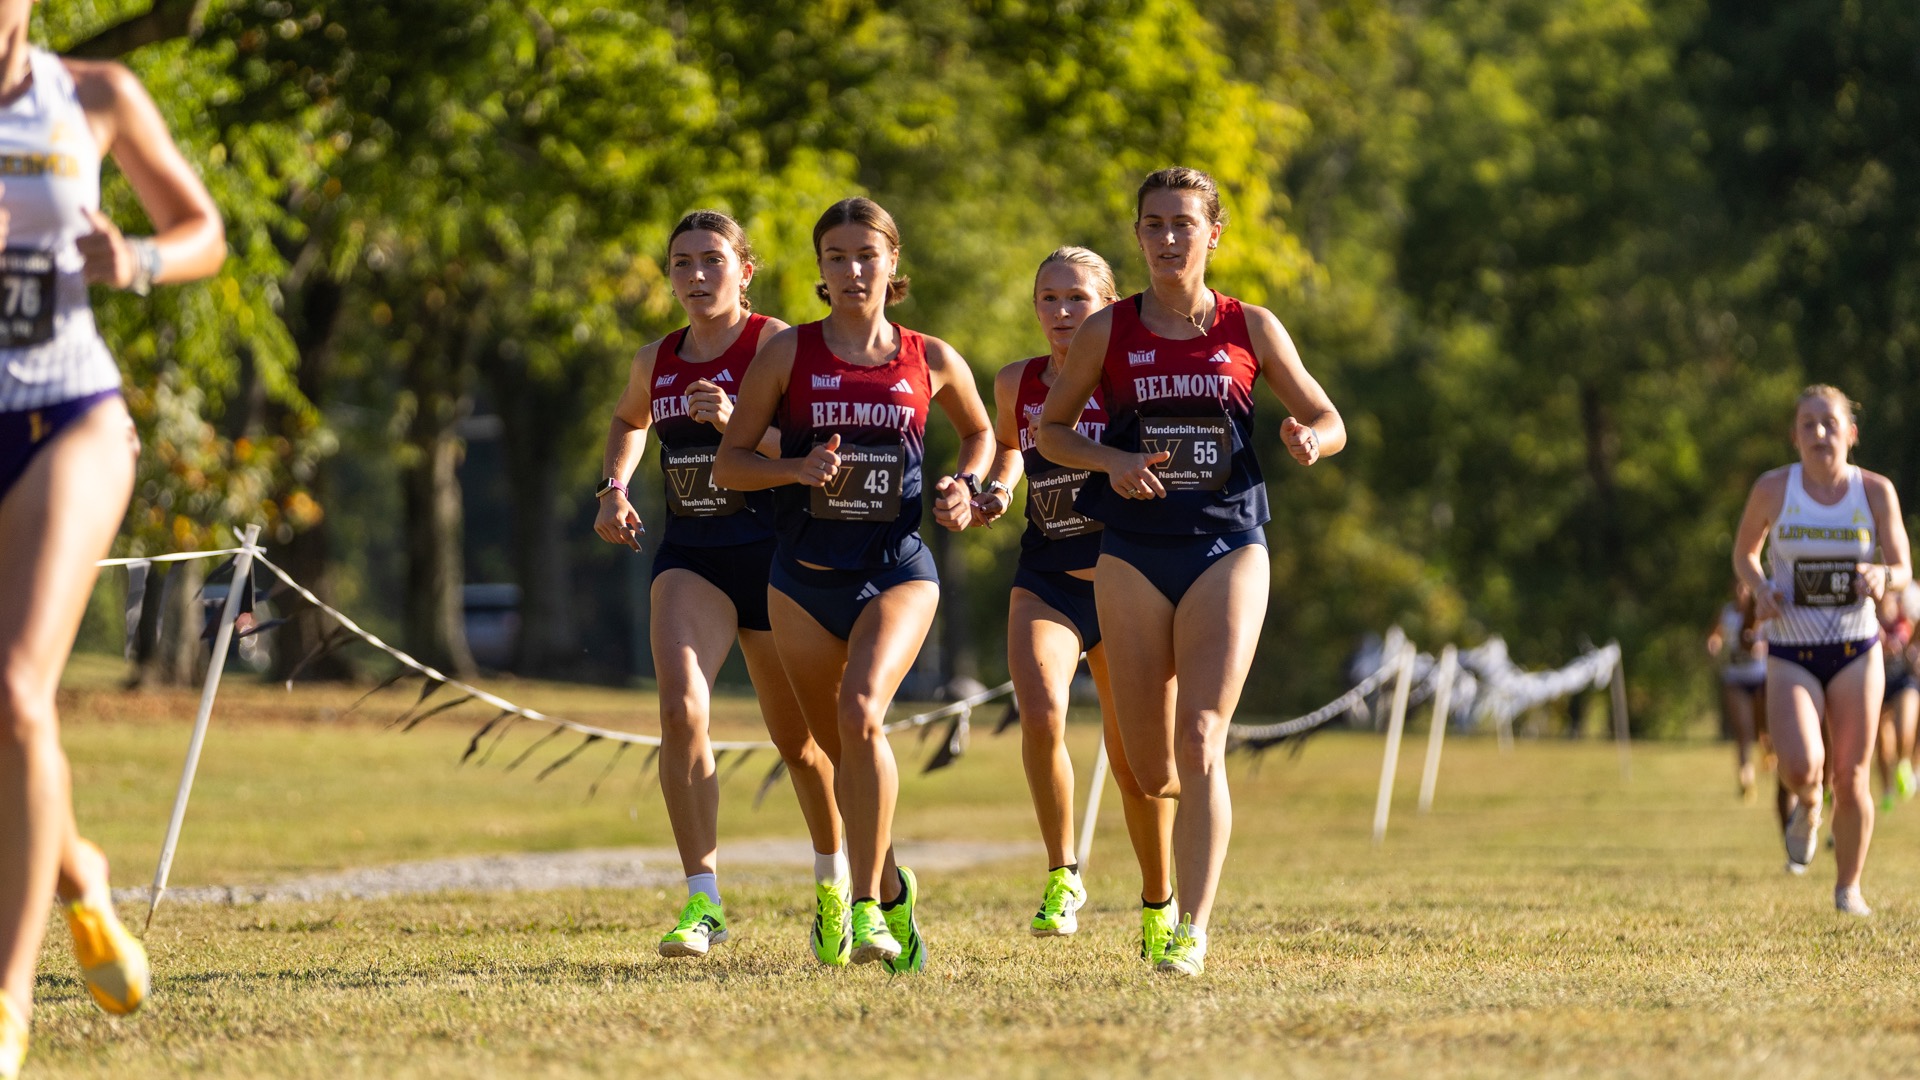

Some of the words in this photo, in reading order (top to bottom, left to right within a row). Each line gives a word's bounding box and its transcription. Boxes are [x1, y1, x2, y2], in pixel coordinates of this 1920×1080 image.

[3, 276, 41, 318] 76
[1128, 349, 1156, 365] VALLEY
[811, 374, 841, 388] VALLEY
[1134, 374, 1233, 403] BELMONT
[811, 401, 915, 432] BELMONT
[1145, 426, 1195, 434] Vanderbilt
[1197, 426, 1225, 434] Invite
[668, 455, 709, 465] Vanderbilt
[870, 453, 898, 463] Invite
[1193, 441, 1218, 465] 55
[863, 470, 890, 494] 43
[1032, 473, 1071, 489] Vanderbilt
[1158, 471, 1199, 480] Nashville,
[1200, 471, 1212, 479] TN
[682, 498, 716, 507] Nashville,
[828, 499, 869, 509] Nashville,
[871, 501, 883, 509] TN
[1046, 516, 1083, 530] Nashville,
[1830, 572, 1850, 594] 82
